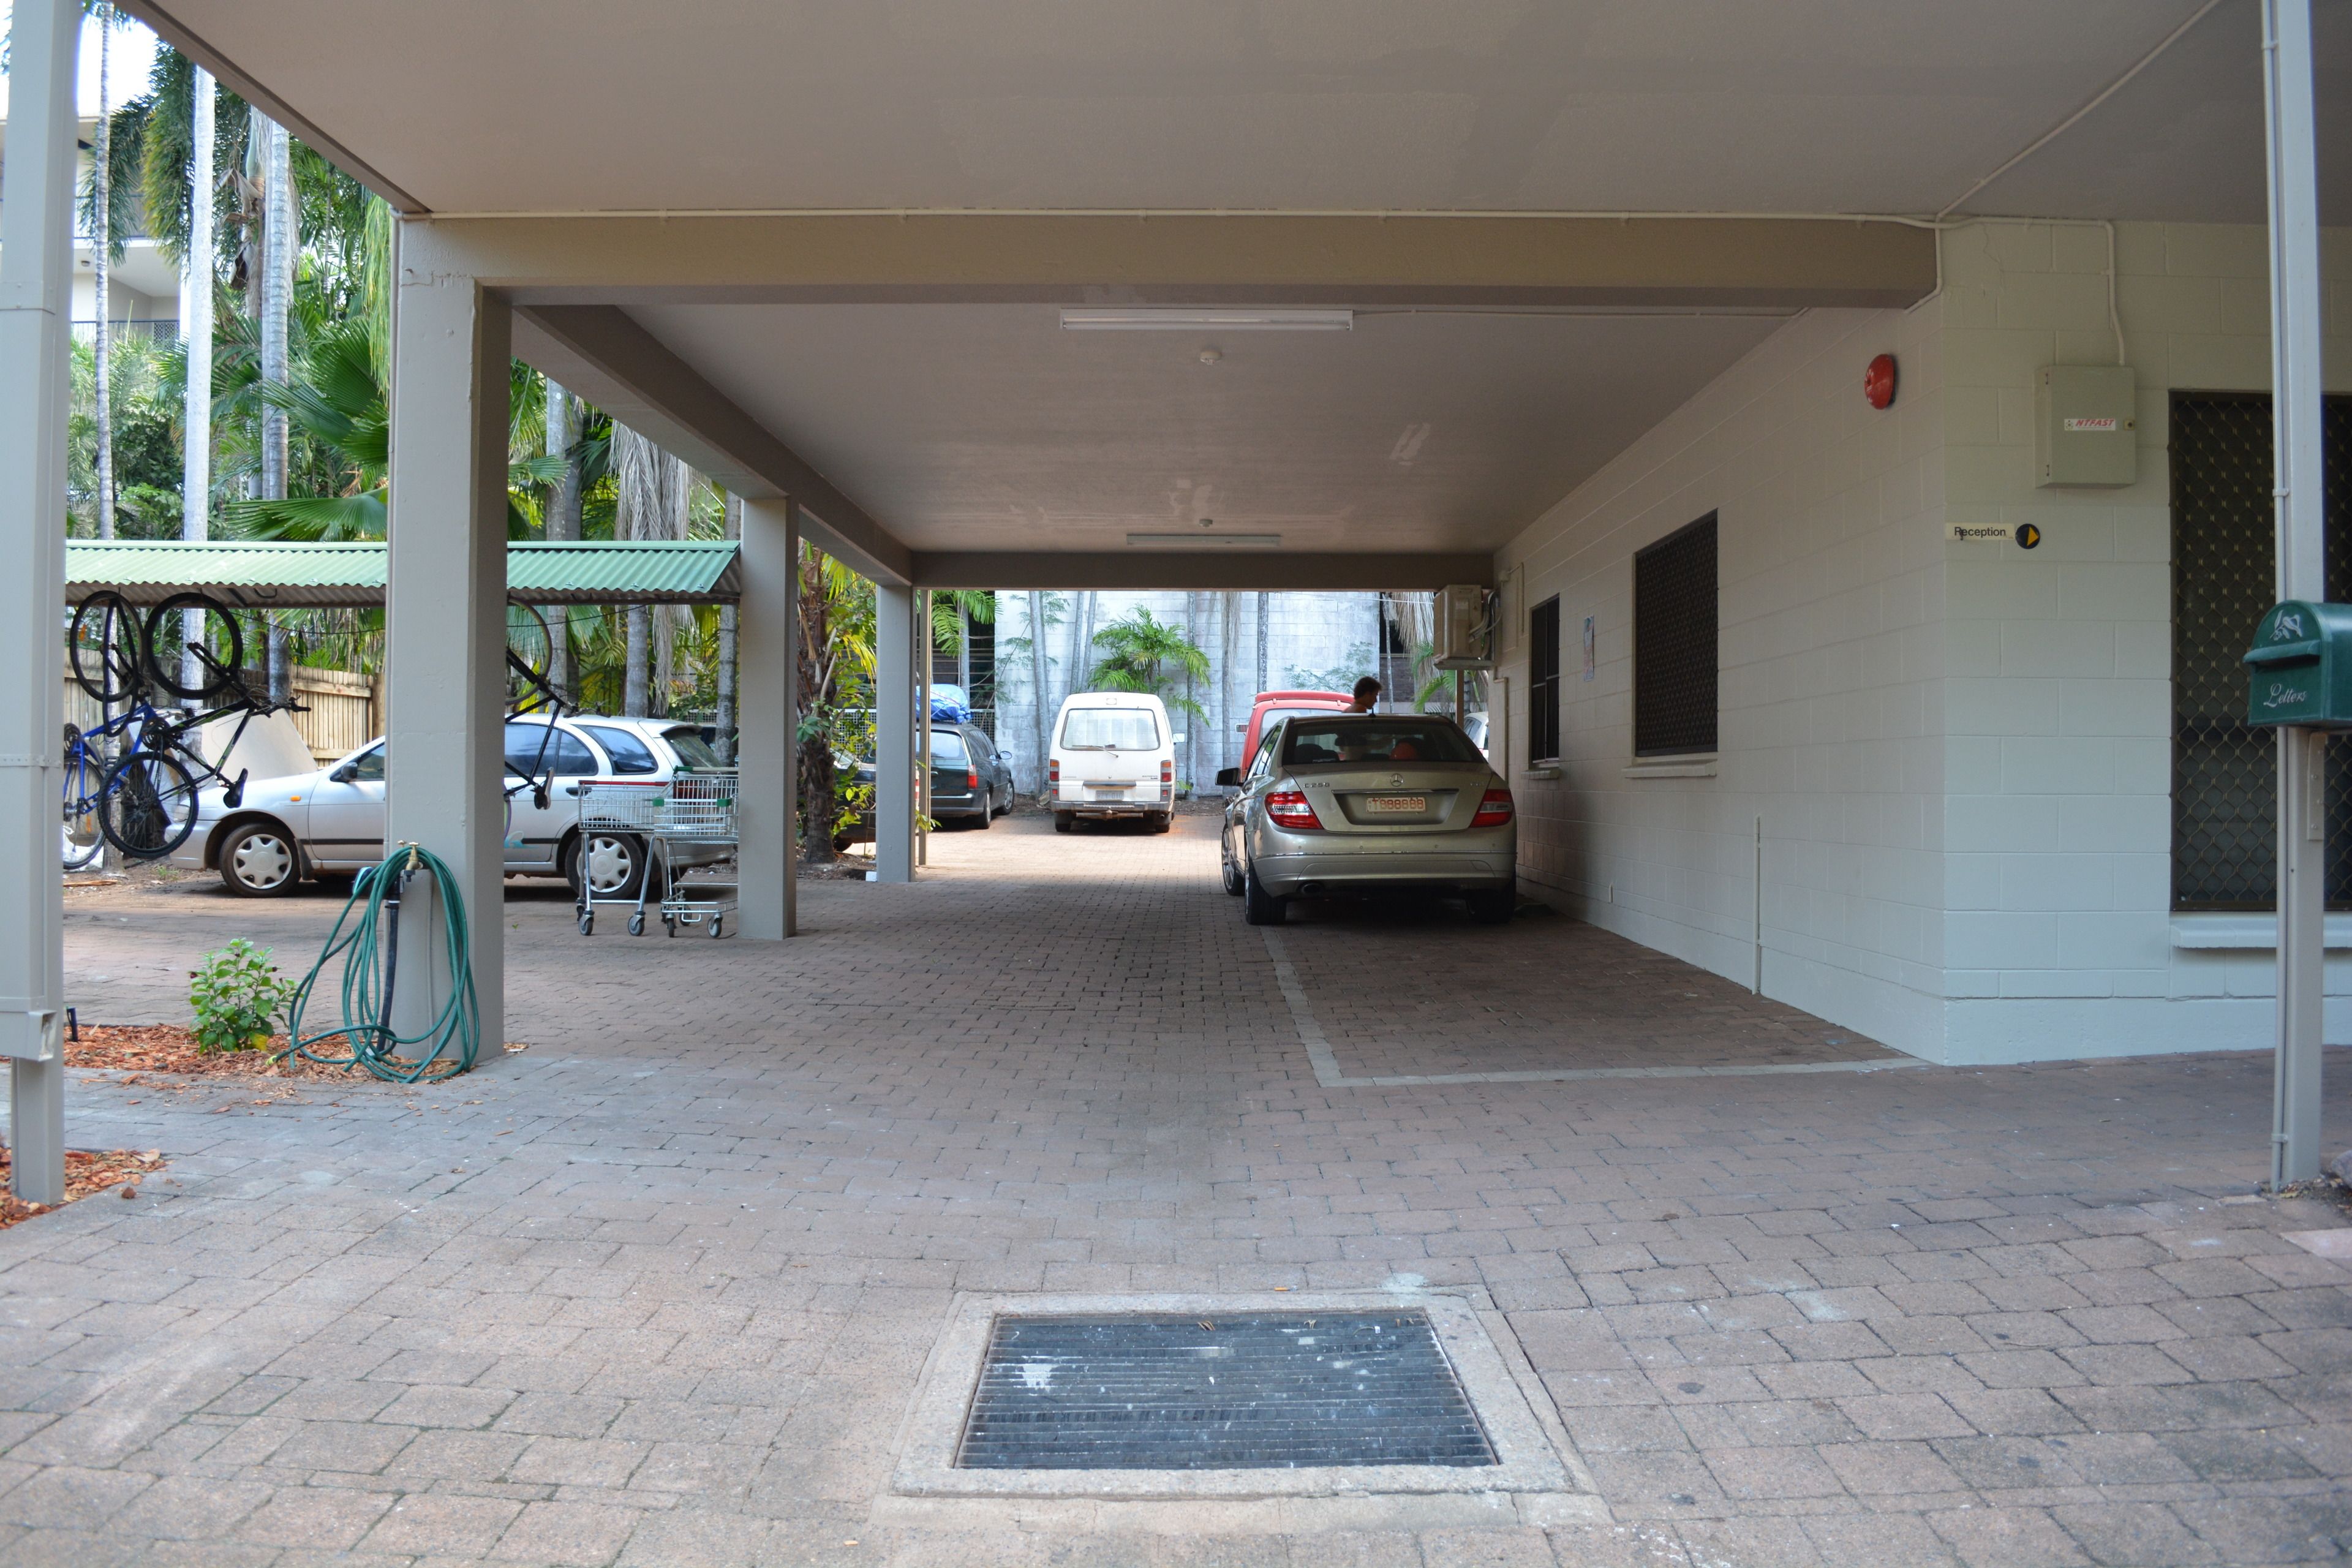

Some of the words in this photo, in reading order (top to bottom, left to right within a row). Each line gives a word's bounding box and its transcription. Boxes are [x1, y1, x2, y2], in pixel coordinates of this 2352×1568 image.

[2075, 418, 2114, 427] NTFAST
[1954, 526, 2006, 538] Reception
[2263, 683, 2307, 707] Letters
